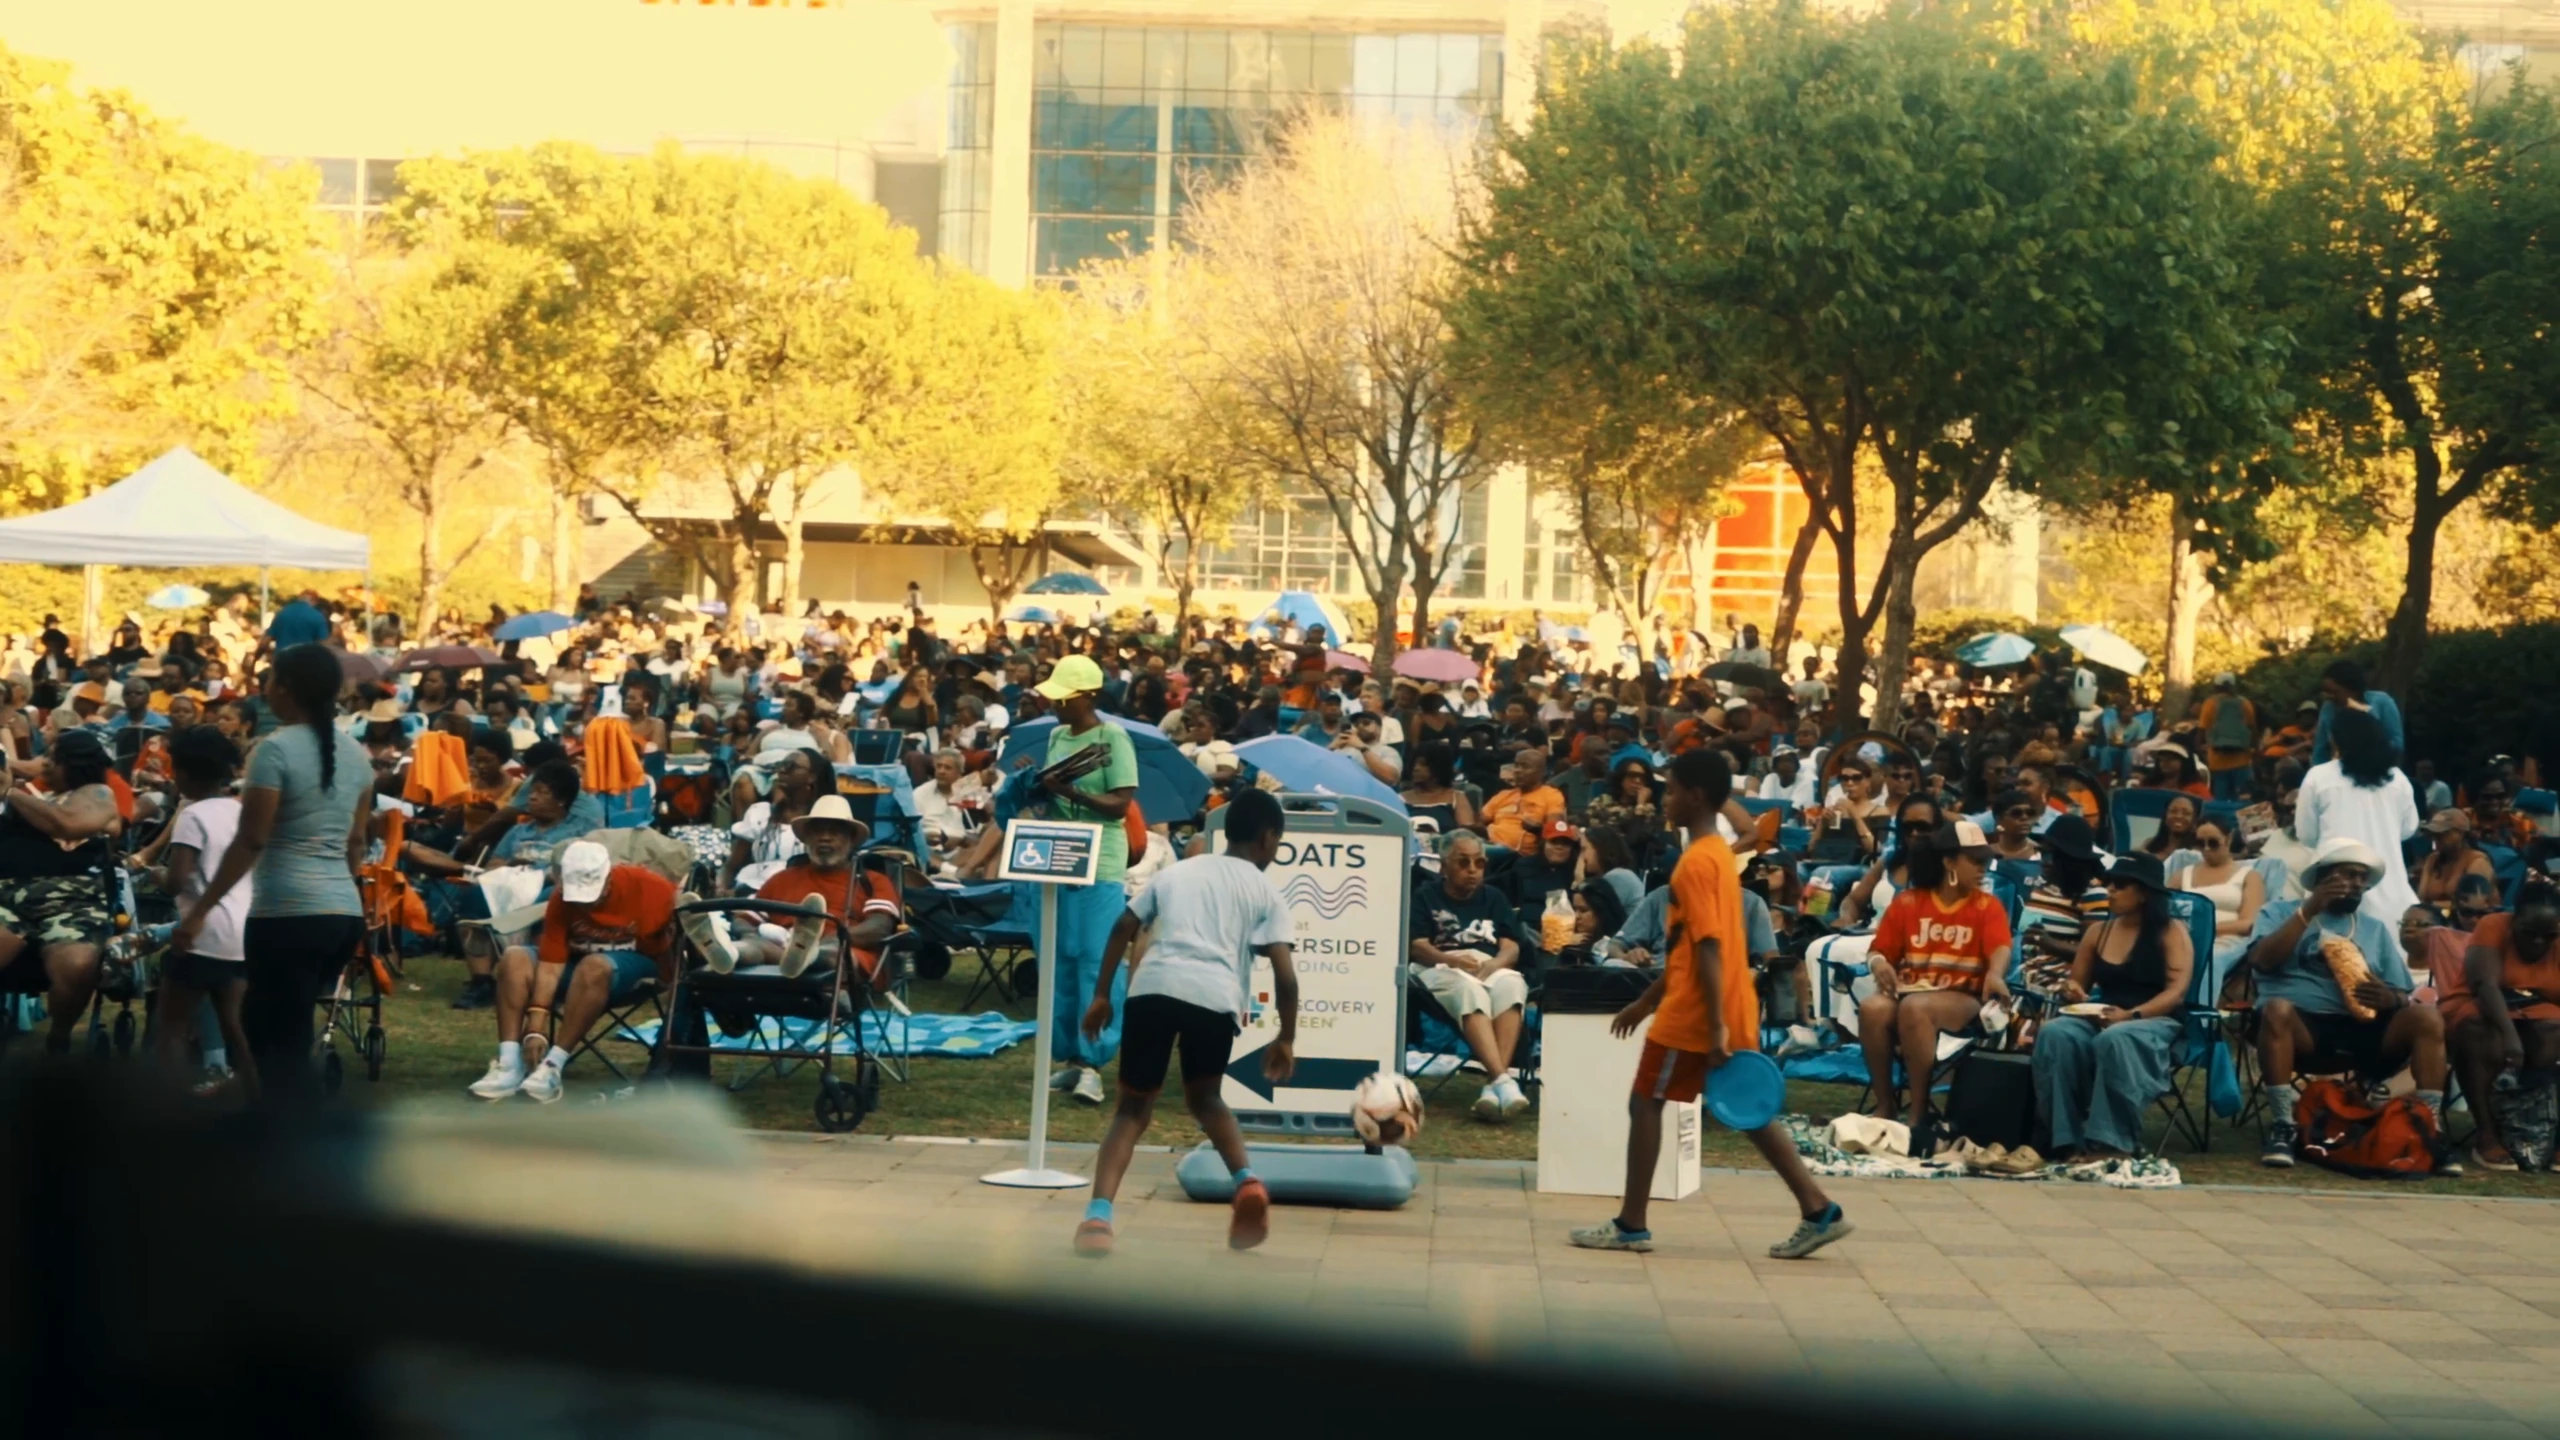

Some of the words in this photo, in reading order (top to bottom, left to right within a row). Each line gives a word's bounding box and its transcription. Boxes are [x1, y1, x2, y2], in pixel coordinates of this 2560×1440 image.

[1273, 841, 1366, 869] OATS
[1294, 920, 1310, 932] at
[1910, 917, 1973, 950] Jeep
[1292, 938, 1378, 956] ERSIDE
[1255, 960, 1350, 975] LDING
[1297, 999, 1375, 1015] SCOVERY
[1272, 1015, 1334, 1029] GEEN
